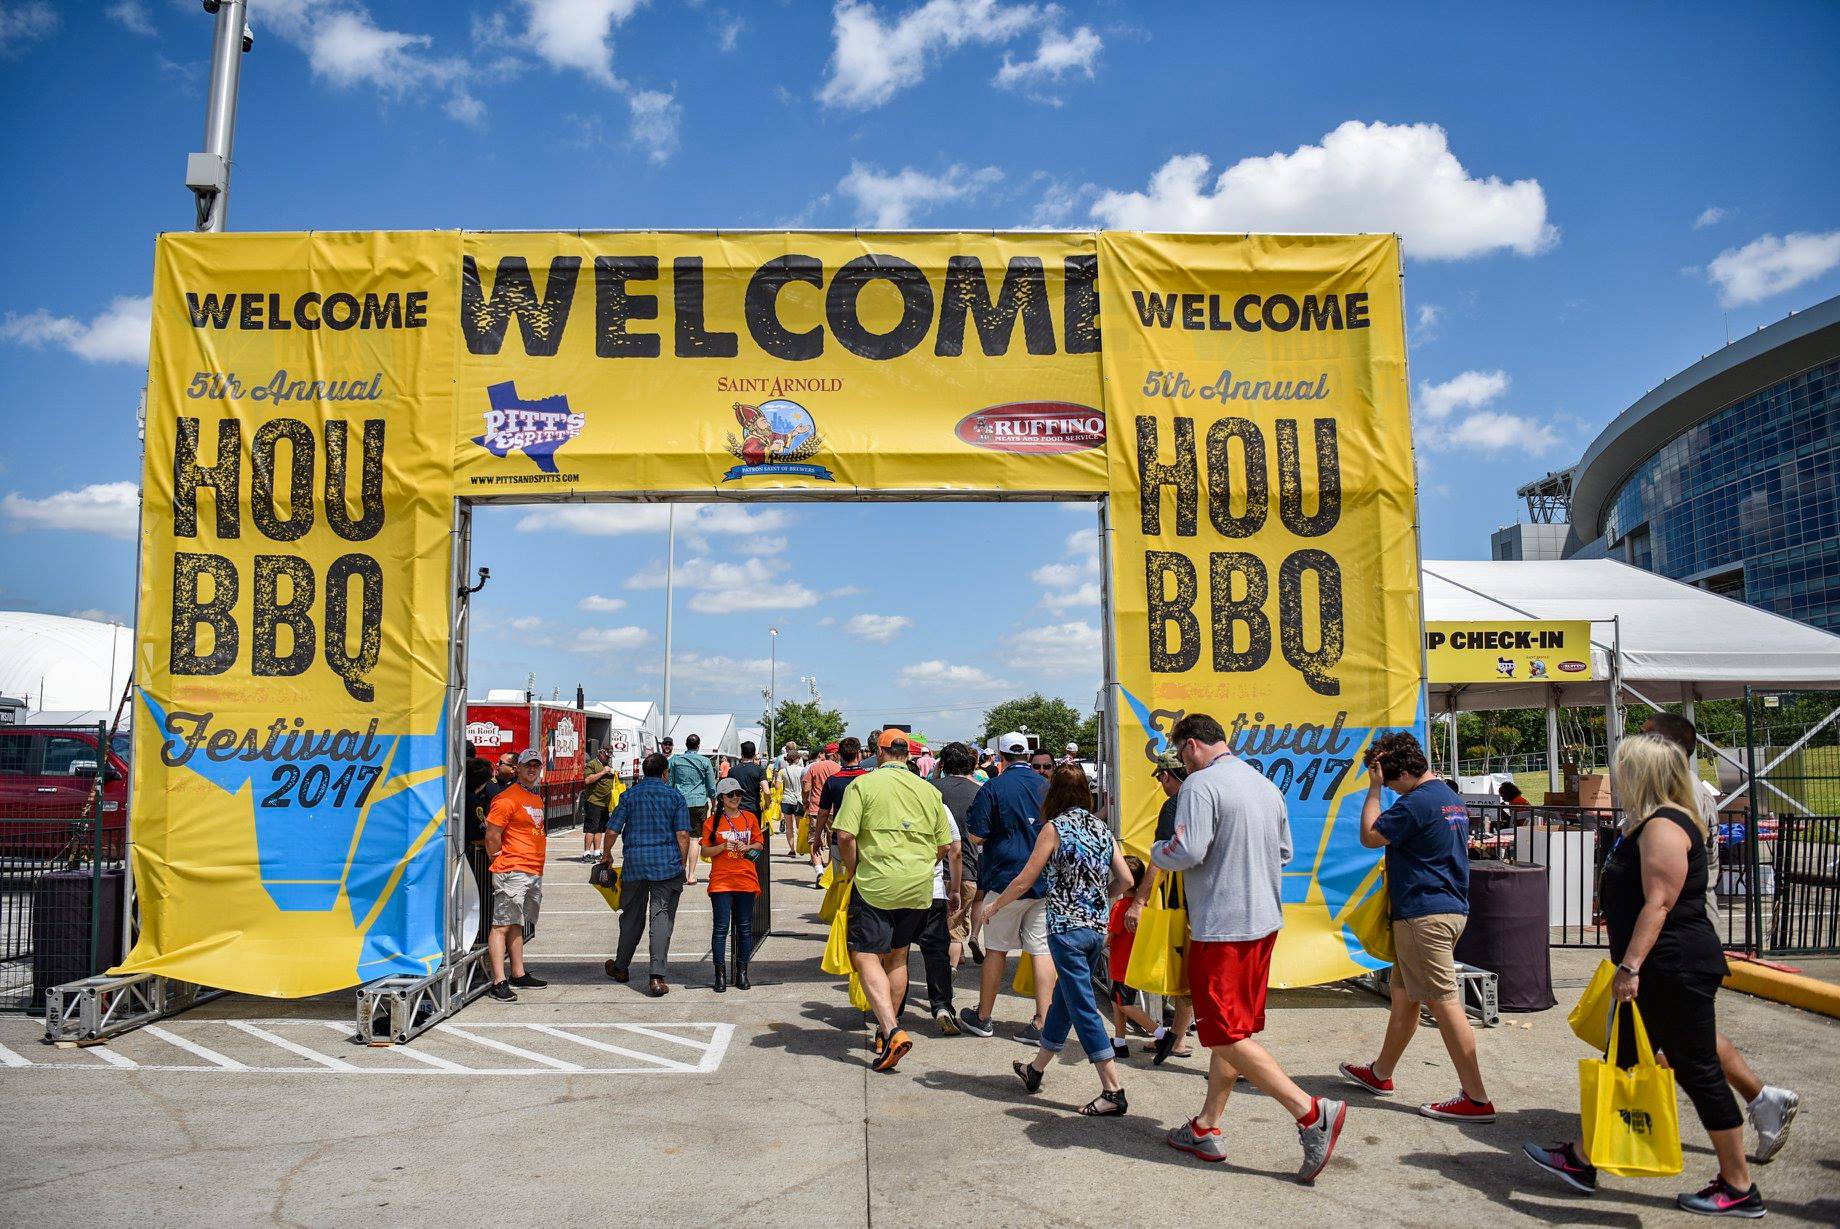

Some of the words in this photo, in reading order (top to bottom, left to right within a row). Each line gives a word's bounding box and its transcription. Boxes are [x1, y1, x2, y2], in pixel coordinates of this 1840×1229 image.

[186, 291, 428, 331] WELCOME
[462, 253, 1101, 361] WELCOME
[1132, 290, 1371, 332] WELCOME
[187, 371, 244, 399] 5th
[250, 369, 383, 405] Annual
[717, 376, 769, 392] SAINT
[768, 376, 845, 397] ARNOLD
[1142, 370, 1196, 399] 5th
[1199, 369, 1330, 405] Annual
[483, 409, 585, 443] PITT'S
[994, 417, 1106, 437] RUFFINO
[994, 434, 1020, 442] MEATS
[1023, 434, 1039, 442] AND
[1041, 434, 1064, 442] FOOD
[1065, 433, 1100, 442] SERVICE
[173, 417, 386, 542] HOU
[1135, 415, 1341, 539] HOU
[168, 552, 384, 702] BBQ
[1144, 548, 1345, 697] BBQ
[1449, 630, 1564, 650] CHECK-IN
[160, 711, 382, 767] Festival
[1145, 709, 1351, 763] Ftival
[260, 763, 383, 809] 2017
